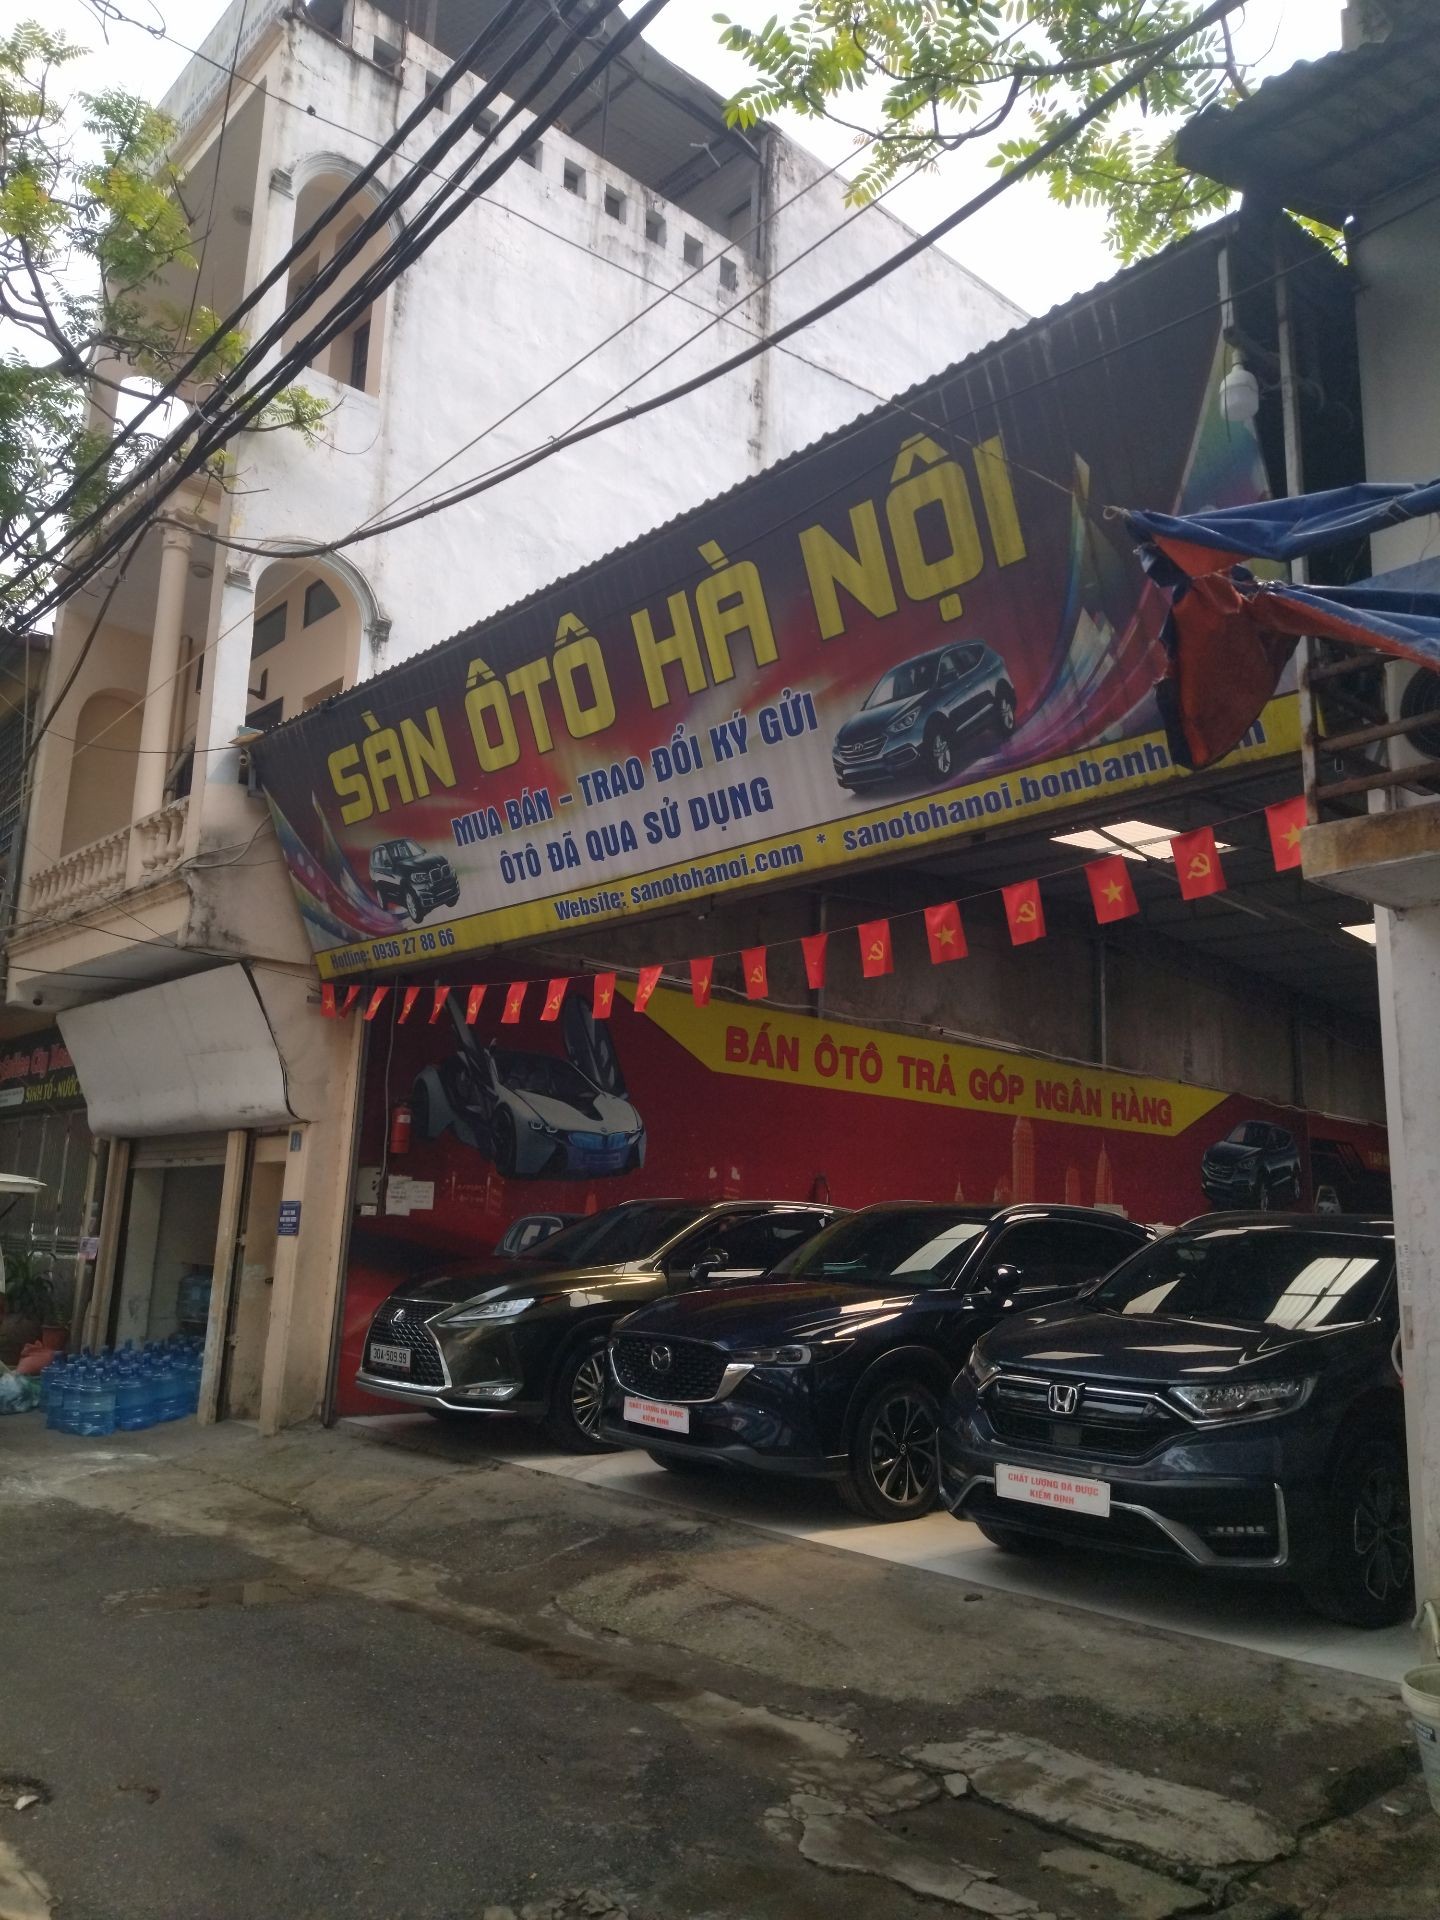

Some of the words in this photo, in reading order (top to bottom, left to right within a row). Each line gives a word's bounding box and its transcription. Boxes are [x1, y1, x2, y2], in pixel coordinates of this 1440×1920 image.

[327, 709, 457, 827] SÀN
[463, 611, 616, 774] ÔTÔ
[630, 539, 779, 709] HÀ
[798, 432, 1028, 641] NỘI
[451, 806, 503, 847] MUA
[505, 788, 553, 831] BÁN
[577, 757, 645, 807] TRAO
[652, 723, 704, 783] ĐỔI
[709, 709, 749, 763] KÝ
[758, 688, 819, 746] GỬI
[499, 842, 543, 885] ÔTÔ
[547, 830, 581, 872] ĐÃ
[585, 819, 639, 861] QUA
[643, 796, 681, 845] SỬ
[688, 776, 774, 832] DỤNG
[553, 890, 626, 921] Website:
[630, 843, 804, 904] sanotohanoi.com
[330, 950, 370, 969] Hotline:
[372, 941, 400, 960] 0936
[403, 937, 417, 954] 27
[420, 933, 436, 951] 88
[438, 928, 455, 946] 66
[725, 1022, 800, 1072] BÁN
[814, 1034, 883, 1084] ÔTÔ
[897, 1054, 956, 1097] TRẢ
[969, 1063, 1024, 1105] GÓP
[1035, 1078, 1102, 1118] NGÂN
[1111, 1079, 1172, 1127] HÀNG
